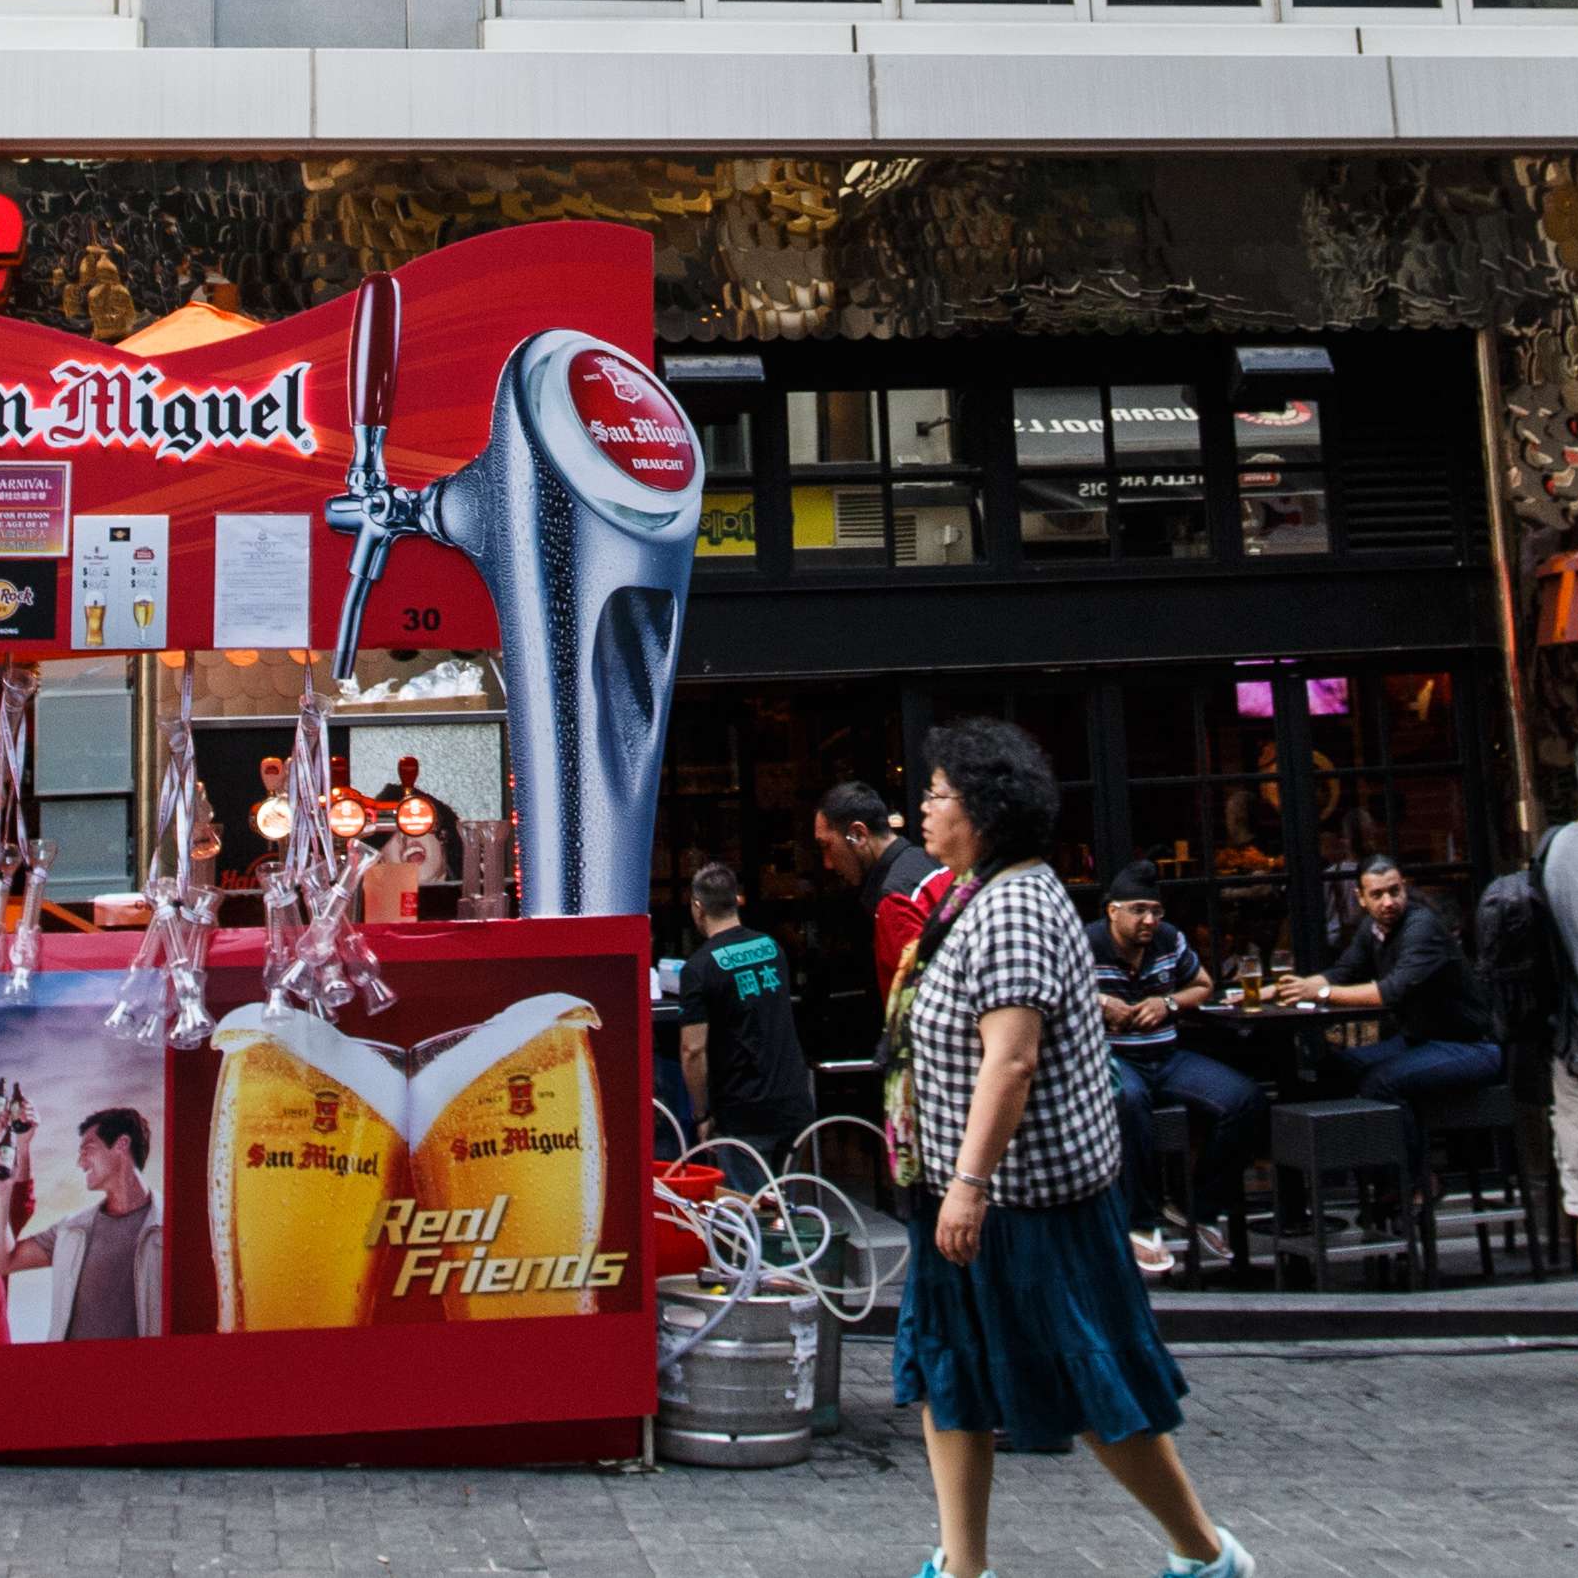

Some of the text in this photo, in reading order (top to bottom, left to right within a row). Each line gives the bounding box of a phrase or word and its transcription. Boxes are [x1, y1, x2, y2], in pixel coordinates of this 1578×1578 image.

[51, 362, 312, 456] Miguel
[588, 419, 635, 444] San
[631, 458, 684, 471] DRAUGHT
[0, 512, 16, 520] FOR
[17, 512, 50, 520] PERSON
[1, 586, 34, 606] Rock
[402, 608, 441, 631] 30
[450, 1125, 582, 1163] San Miguel
[246, 1142, 379, 1177] San Miguel
[365, 1193, 509, 1247] Real
[392, 1244, 629, 1298] Friends
